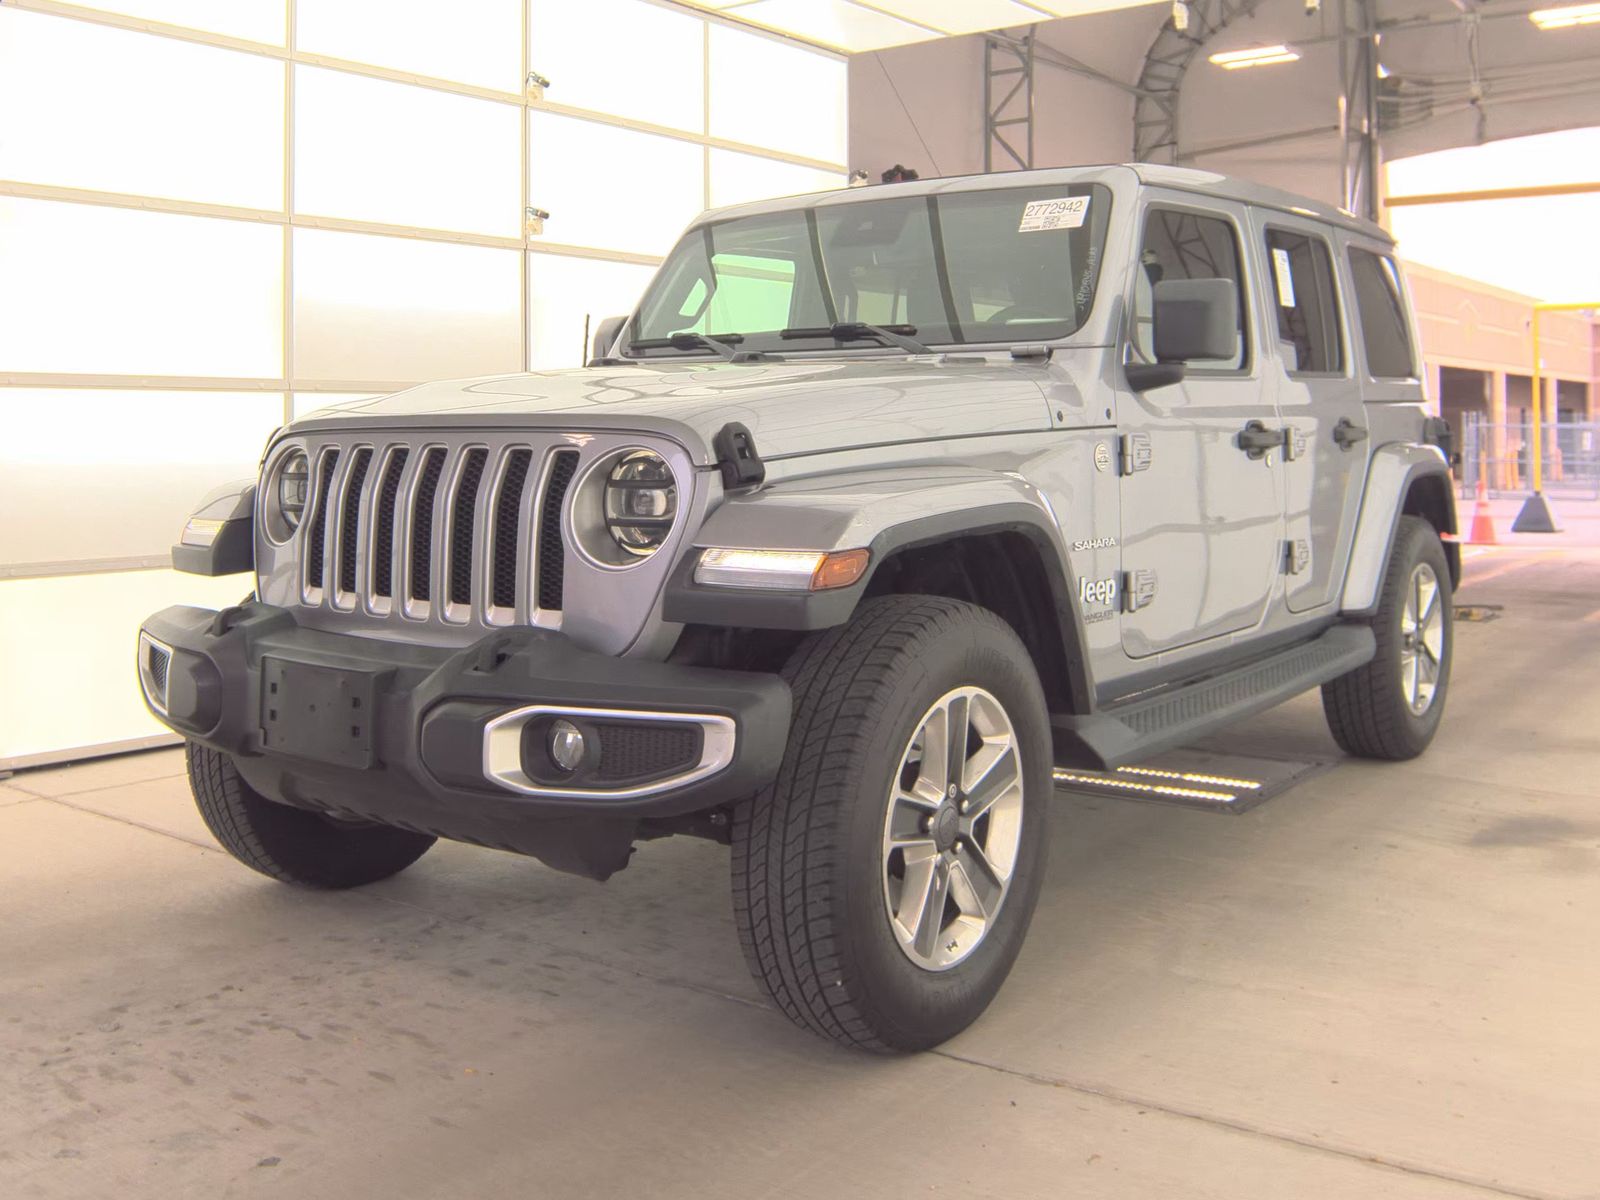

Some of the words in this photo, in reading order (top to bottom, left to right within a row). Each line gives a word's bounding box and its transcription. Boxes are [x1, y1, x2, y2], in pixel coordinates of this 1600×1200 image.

[1025, 200, 1083, 217] 2772942
[1073, 537, 1117, 551] SAHARA
[1079, 576, 1116, 605] Jeep
